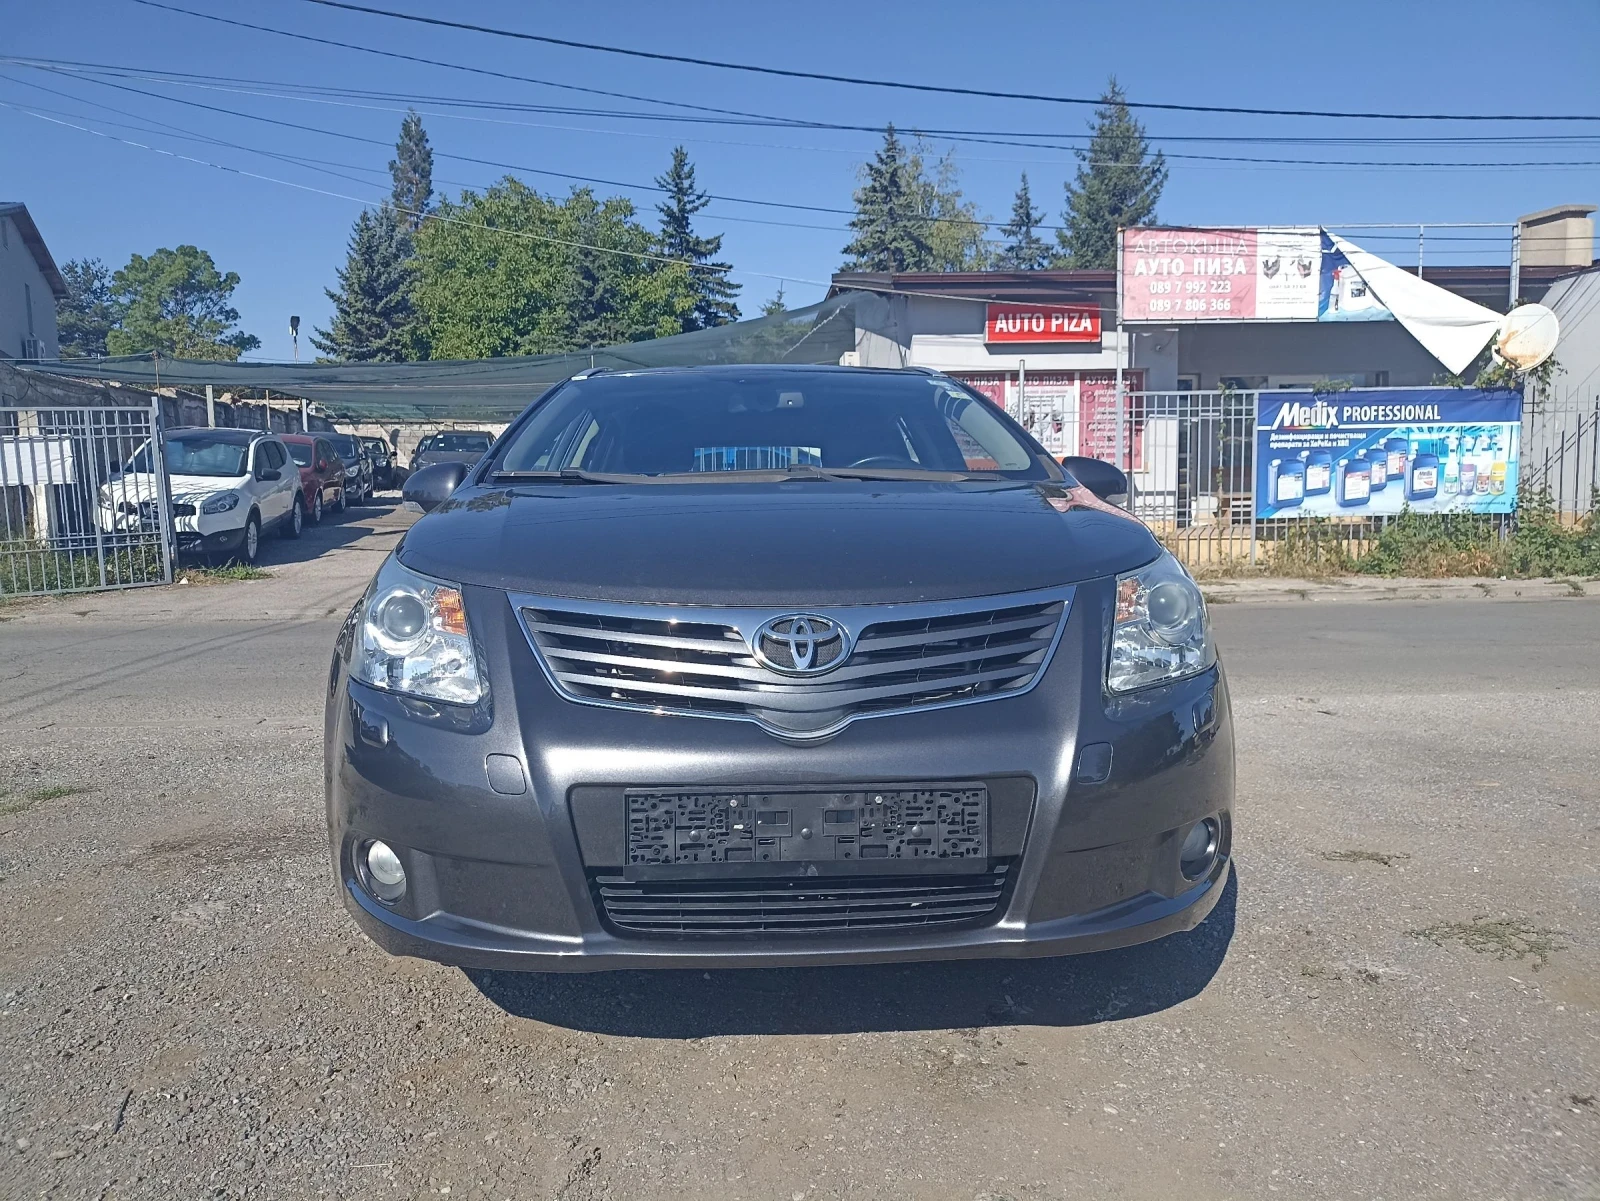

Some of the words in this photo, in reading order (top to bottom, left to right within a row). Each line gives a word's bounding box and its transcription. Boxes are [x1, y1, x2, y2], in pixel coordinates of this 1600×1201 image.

[1134, 238, 1248, 256] АВТОКЪЩА
[1134, 257, 1184, 276] АУТО
[1193, 257, 1247, 275] ПИЗА
[1149, 280, 1171, 294] 089
[1175, 280, 1182, 294] 7
[1185, 280, 1207, 294] 992
[1210, 280, 1232, 294] 223
[1149, 299, 1171, 313] 089
[1175, 299, 1182, 313] 7
[1185, 298, 1207, 312] 806
[1210, 298, 1231, 312] 366
[995, 312, 1045, 333] AUTO
[1051, 312, 1093, 332] PIZA
[973, 376, 1000, 386] ПИЗА
[1042, 376, 1069, 385] ПИЗА
[1085, 375, 1108, 385] АУТО
[1112, 375, 1138, 385] ПЗА
[1271, 401, 1339, 430] Medix
[1343, 404, 1441, 422] PROFESSIONAL
